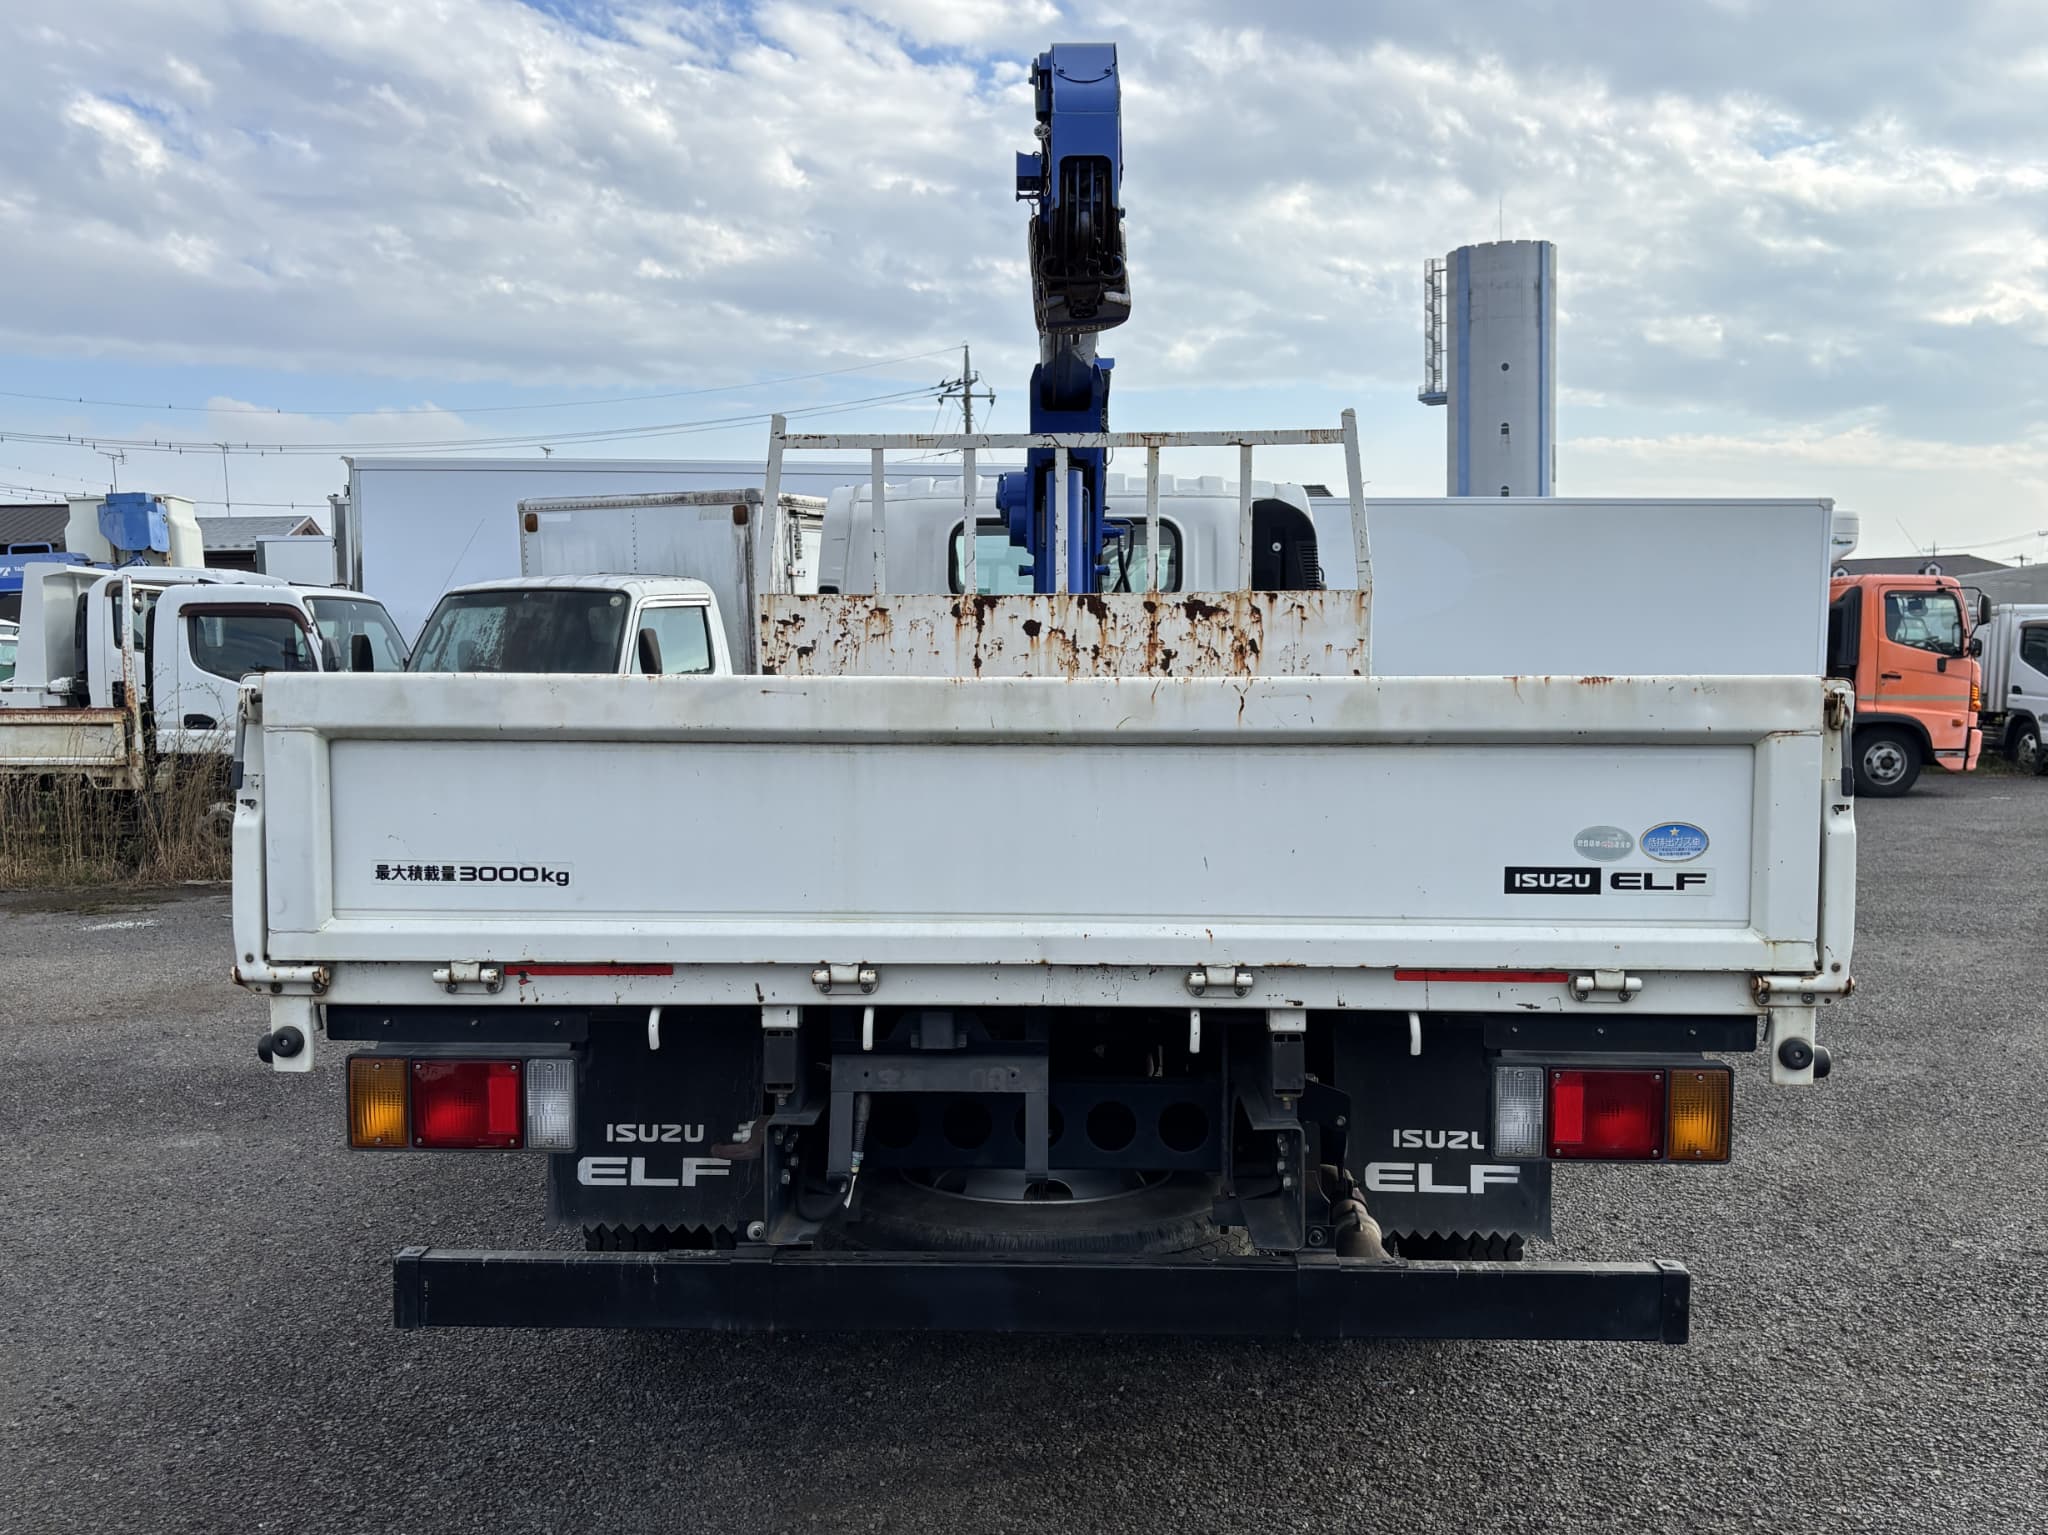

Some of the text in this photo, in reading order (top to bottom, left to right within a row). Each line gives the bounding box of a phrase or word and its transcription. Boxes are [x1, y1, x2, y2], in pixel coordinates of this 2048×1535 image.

[1514, 872, 1707, 891] ISUZU ELF
[606, 1123, 705, 1143] ISUZU
[577, 1156, 732, 1187] ELF
[1364, 1162, 1521, 1194] ELF
